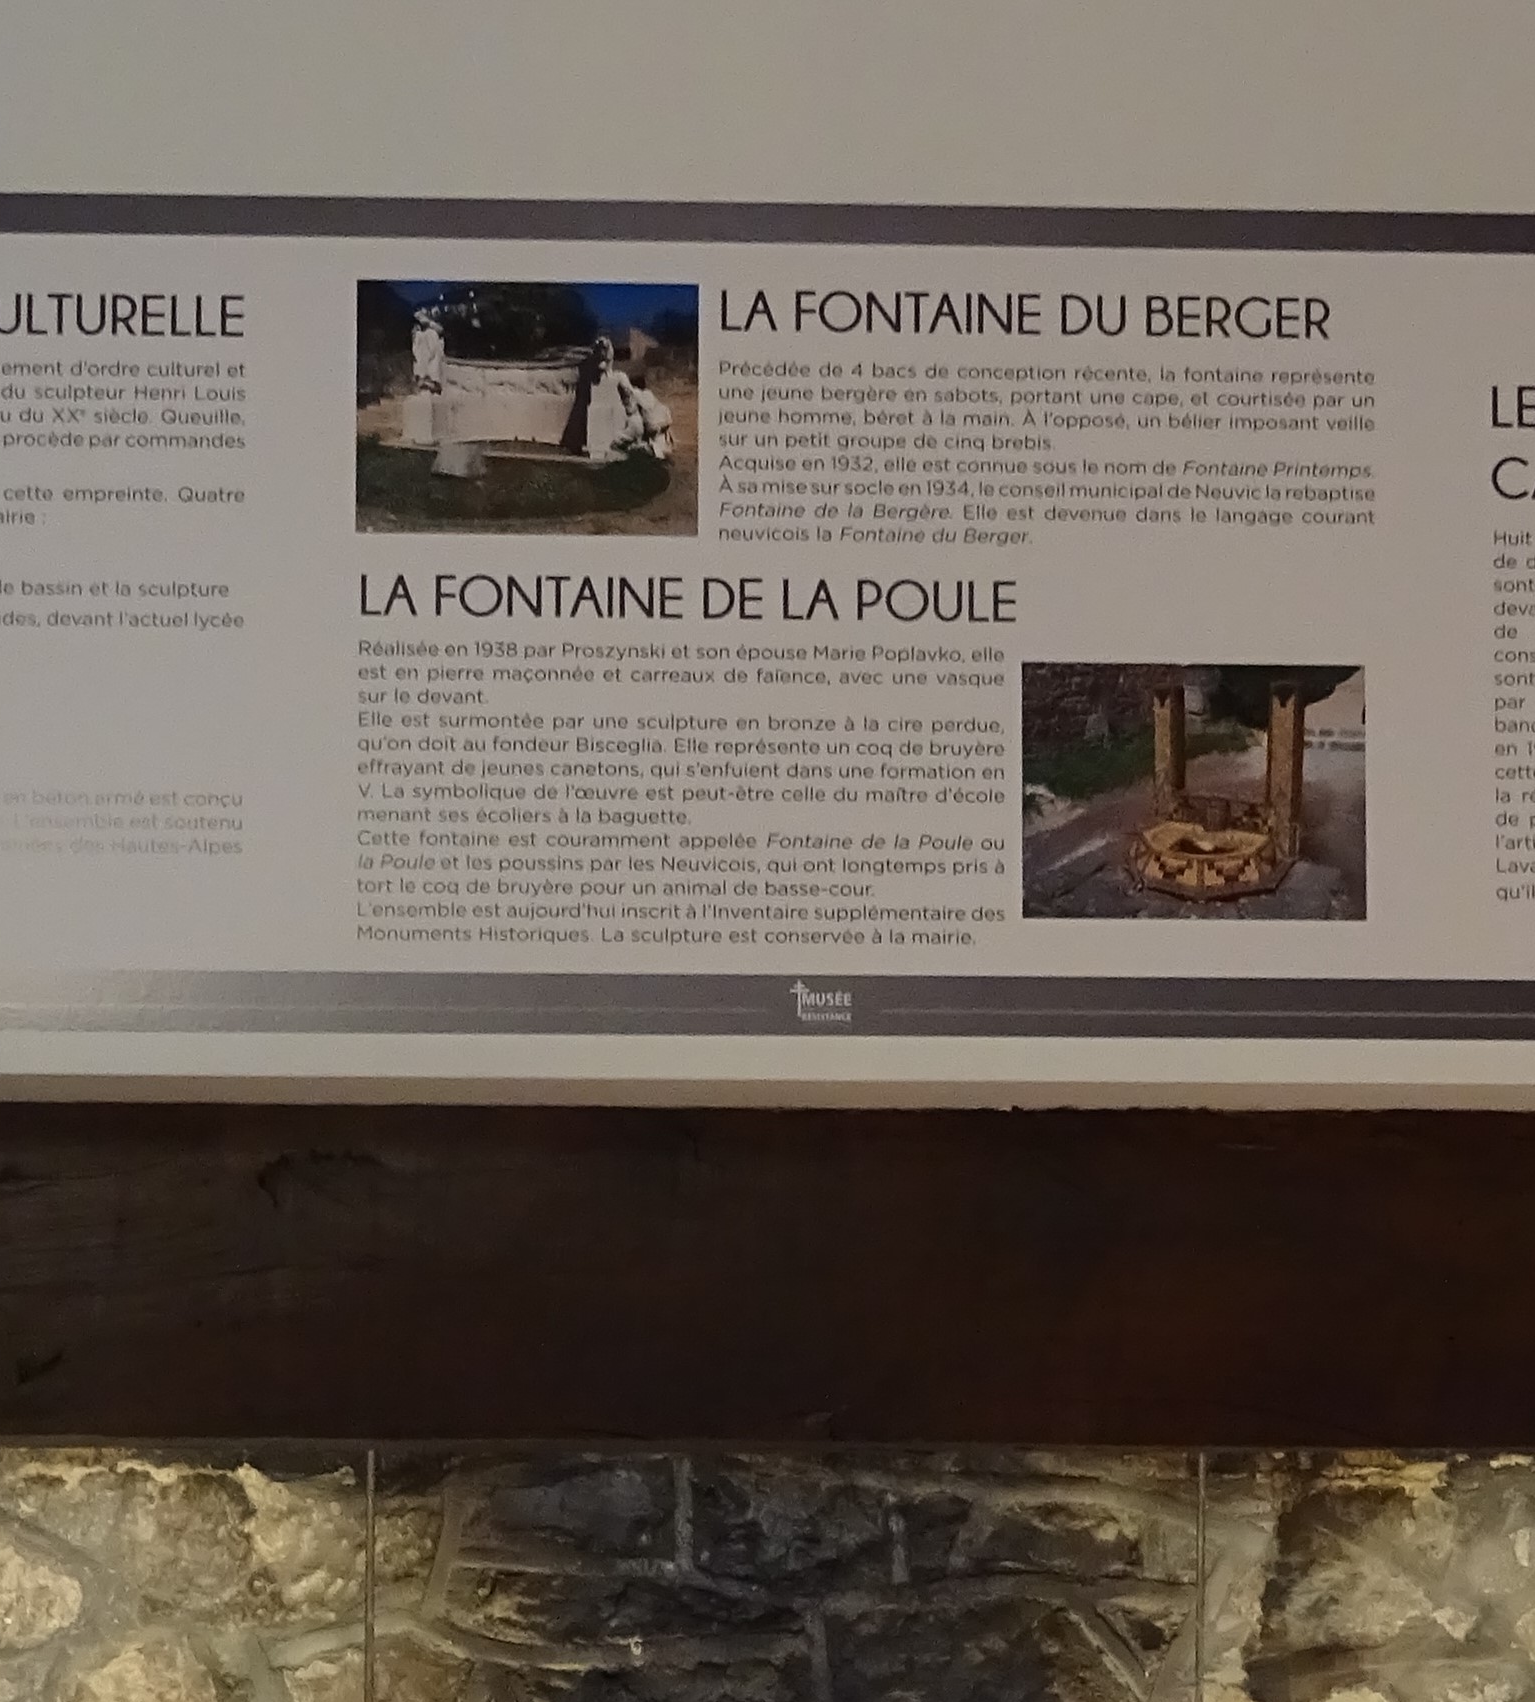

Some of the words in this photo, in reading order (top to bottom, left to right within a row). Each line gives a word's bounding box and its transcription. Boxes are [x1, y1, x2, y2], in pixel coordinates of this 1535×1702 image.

[720, 290, 778, 333] LA
[794, 291, 1041, 335] FONTAINE
[1061, 294, 1126, 336] DU
[1145, 295, 1330, 340] BERGER
[69, 358, 141, 376] d'ordre
[146, 359, 221, 377] culturel
[226, 360, 246, 377] et
[718, 358, 811, 377] Précédée
[818, 360, 843, 377] de
[850, 360, 863, 378] 4
[871, 360, 917, 378] bacs
[924, 361, 949, 379] de
[956, 361, 1066, 384] conception
[1074, 363, 1151, 384] récente,
[1160, 364, 1176, 382] la
[1183, 364, 1264, 383] fontaine
[1271, 365, 1375, 388] représente
[718, 433, 748, 447] sur
[754, 433, 779, 447] un
[785, 430, 829, 451] petit
[836, 434, 907, 452] groupe
[913, 431, 938, 449] de
[944, 432, 985, 453] cinq
[718, 523, 810, 541] neuvicois
[816, 524, 833, 541] la
[839, 524, 926, 543] Fontaine
[931, 525, 957, 543] du
[963, 526, 1033, 547] Berger.
[1493, 528, 1532, 546] Huit
[1493, 575, 1534, 593] sont
[360, 574, 416, 617] LA
[435, 575, 684, 619] FONTAINE
[703, 578, 763, 620] DE
[782, 579, 839, 621] LA
[856, 579, 1016, 623] POULE
[1493, 620, 1518, 638] de
[358, 638, 440, 657] Réalisée
[444, 643, 468, 657] en
[474, 639, 518, 657] 1938
[523, 644, 557, 661] par
[561, 640, 666, 662] Proszynski
[671, 641, 690, 659] et
[696, 646, 731, 659] son
[735, 642, 808, 664] épouse
[813, 643, 866, 661] Marie
[871, 643, 966, 665] Poplavko,
[971, 644, 1005, 662] elle
[358, 690, 387, 704] sur
[394, 686, 411, 704] le
[416, 686, 489, 704] devant.
[1494, 696, 1526, 713] par
[1494, 743, 1518, 757] en
[357, 804, 432, 822] menant
[438, 809, 470, 822] ses
[476, 805, 552, 823] écoliers
[558, 806, 569, 823] à
[576, 806, 592, 824] la
[598, 806, 691, 828] baguette.
[1495, 882, 1535, 903] qu'il
[356, 923, 472, 942] Monuments
[601, 925, 625, 943] La
[631, 925, 723, 947] sculpture
[728, 926, 757, 943] est
[764, 926, 866, 944] conservée
[871, 927, 883, 944] à
[889, 927, 905, 944] la
[911, 927, 976, 945] mairie.
[802, 990, 852, 1007] MUSÉE
